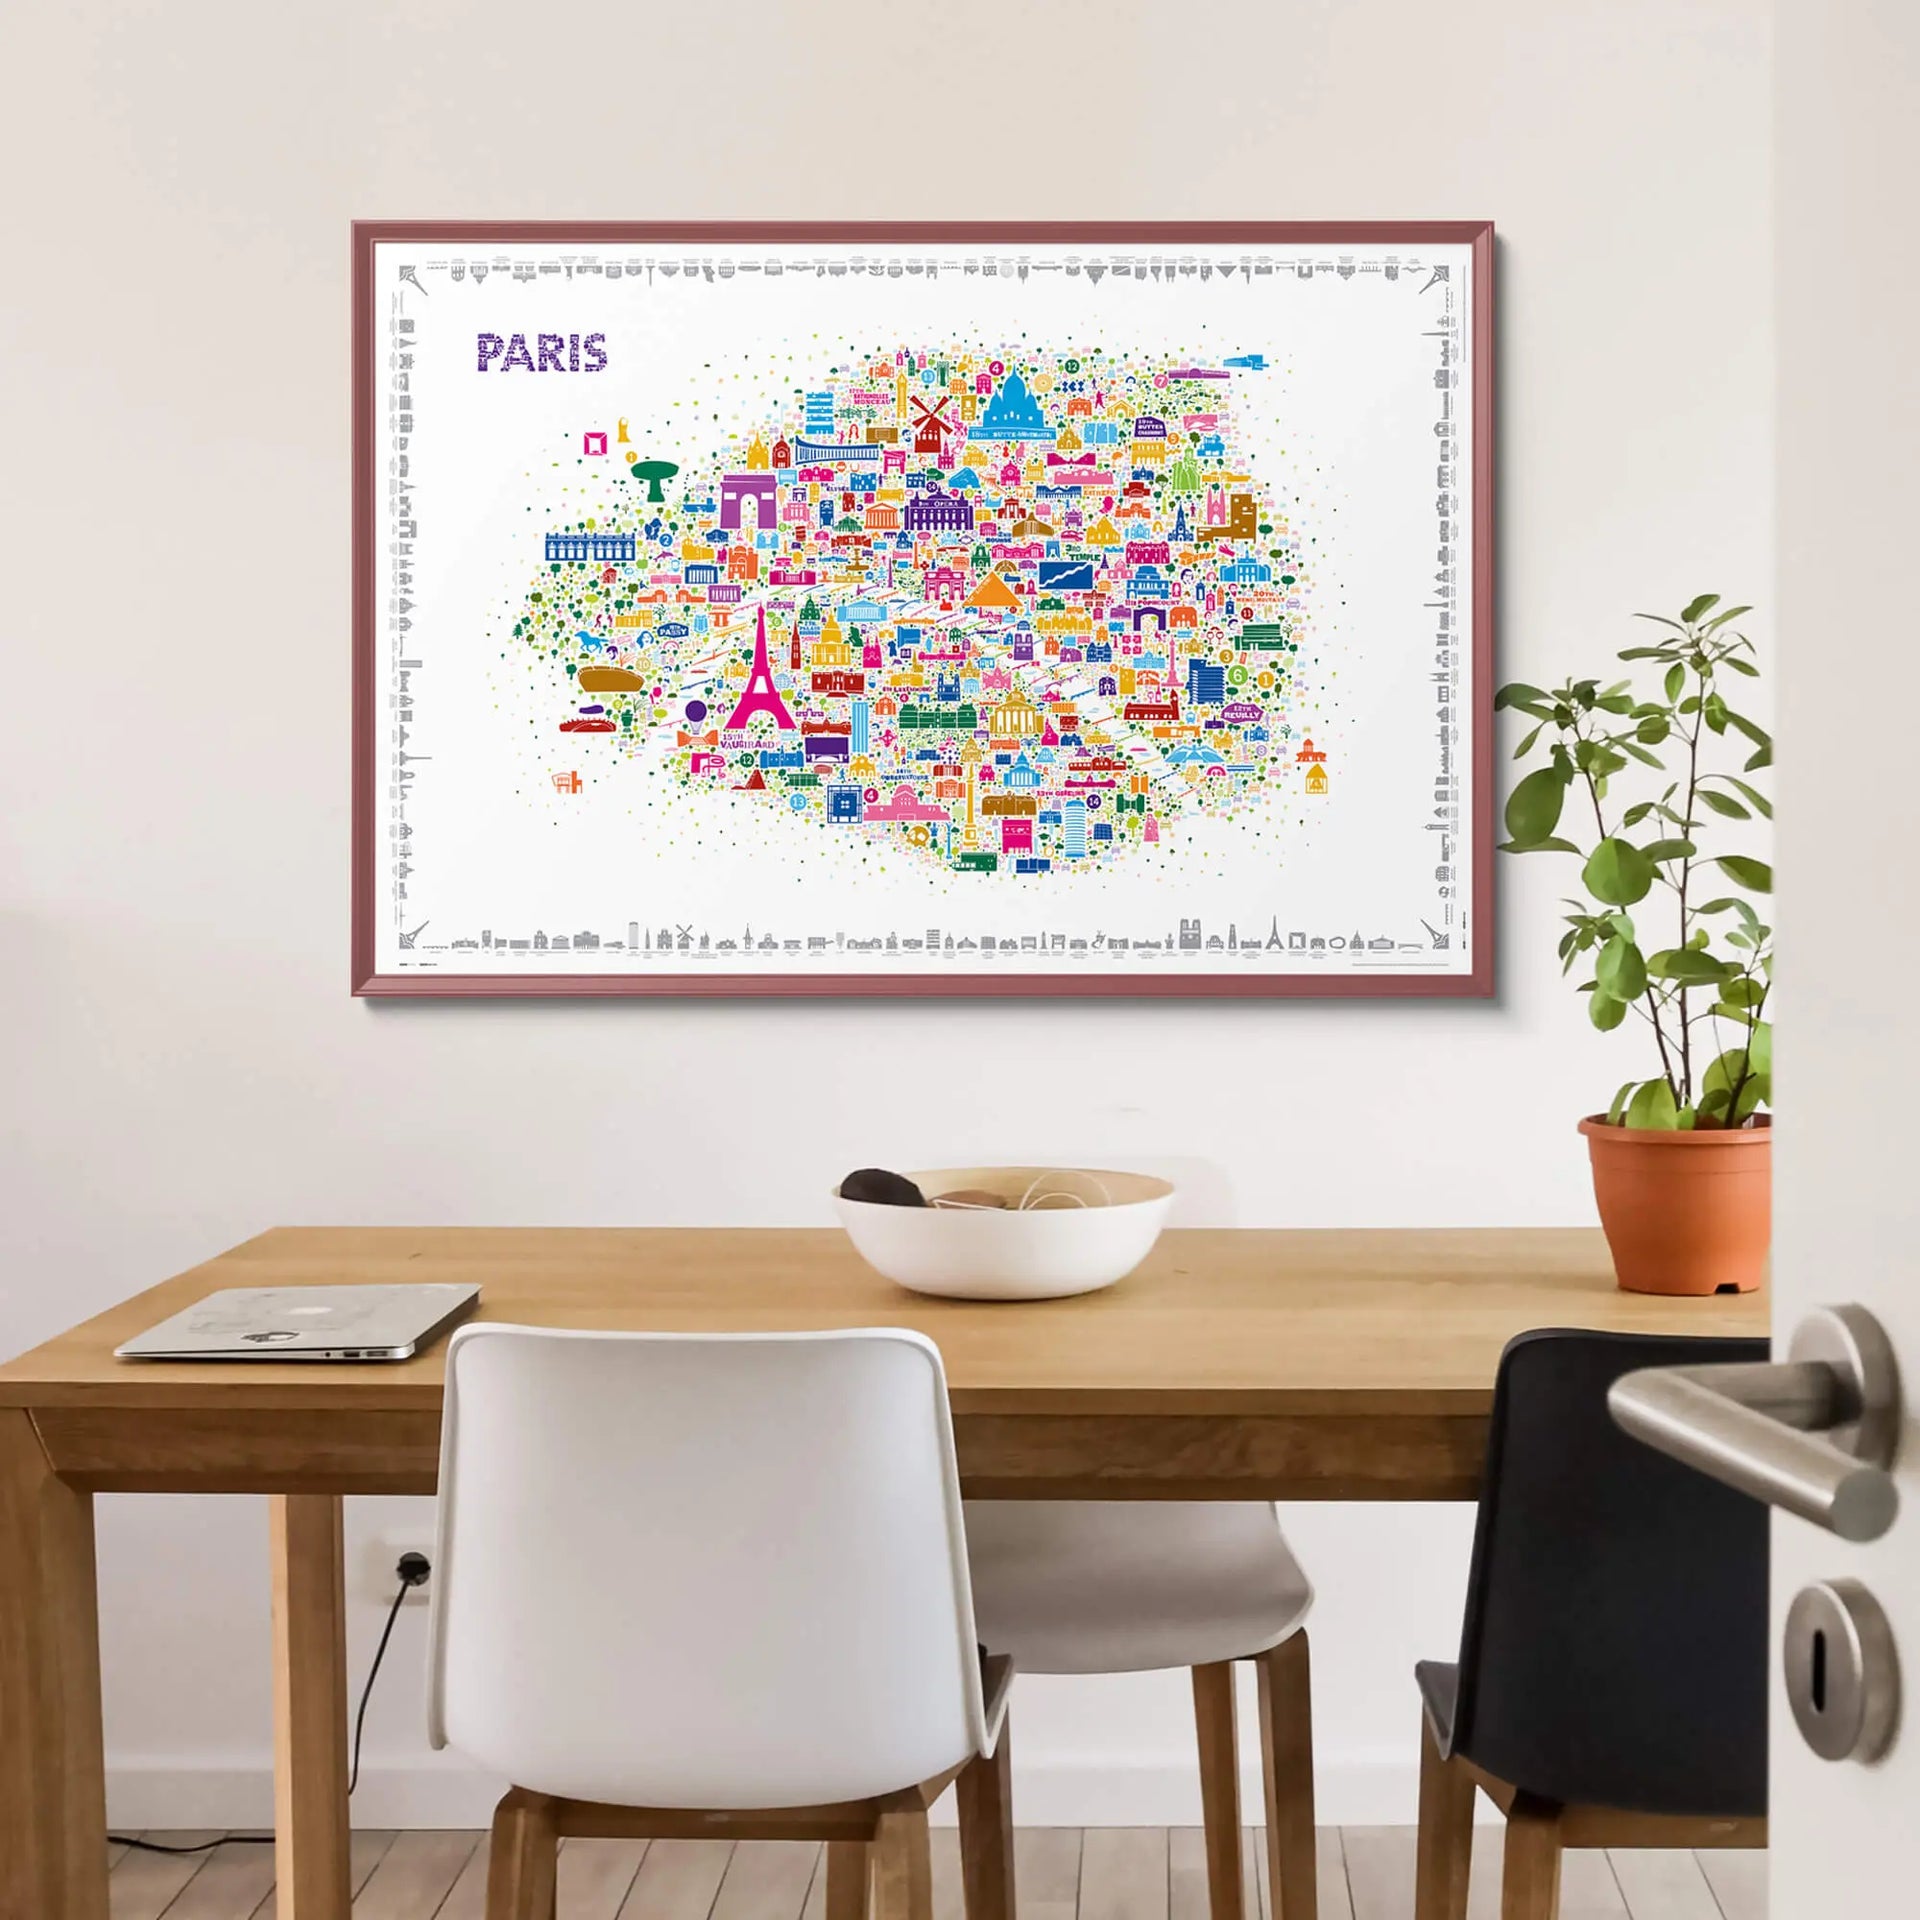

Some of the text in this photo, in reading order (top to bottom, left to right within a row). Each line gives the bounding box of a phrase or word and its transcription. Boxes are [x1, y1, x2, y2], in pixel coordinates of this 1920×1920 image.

[478, 333, 607, 372] PARIS
[993, 363, 1000, 373] 4
[1067, 361, 1078, 371] 12
[1157, 377, 1165, 387] 7
[662, 535, 670, 545] 2
[1066, 544, 1081, 552] 3RD
[1233, 669, 1243, 683] 6
[1263, 674, 1269, 686] 1
[720, 740, 774, 749] VAUGIRARD
[742, 755, 752, 765] 12
[867, 791, 875, 800] 4
[793, 797, 804, 807] 13
